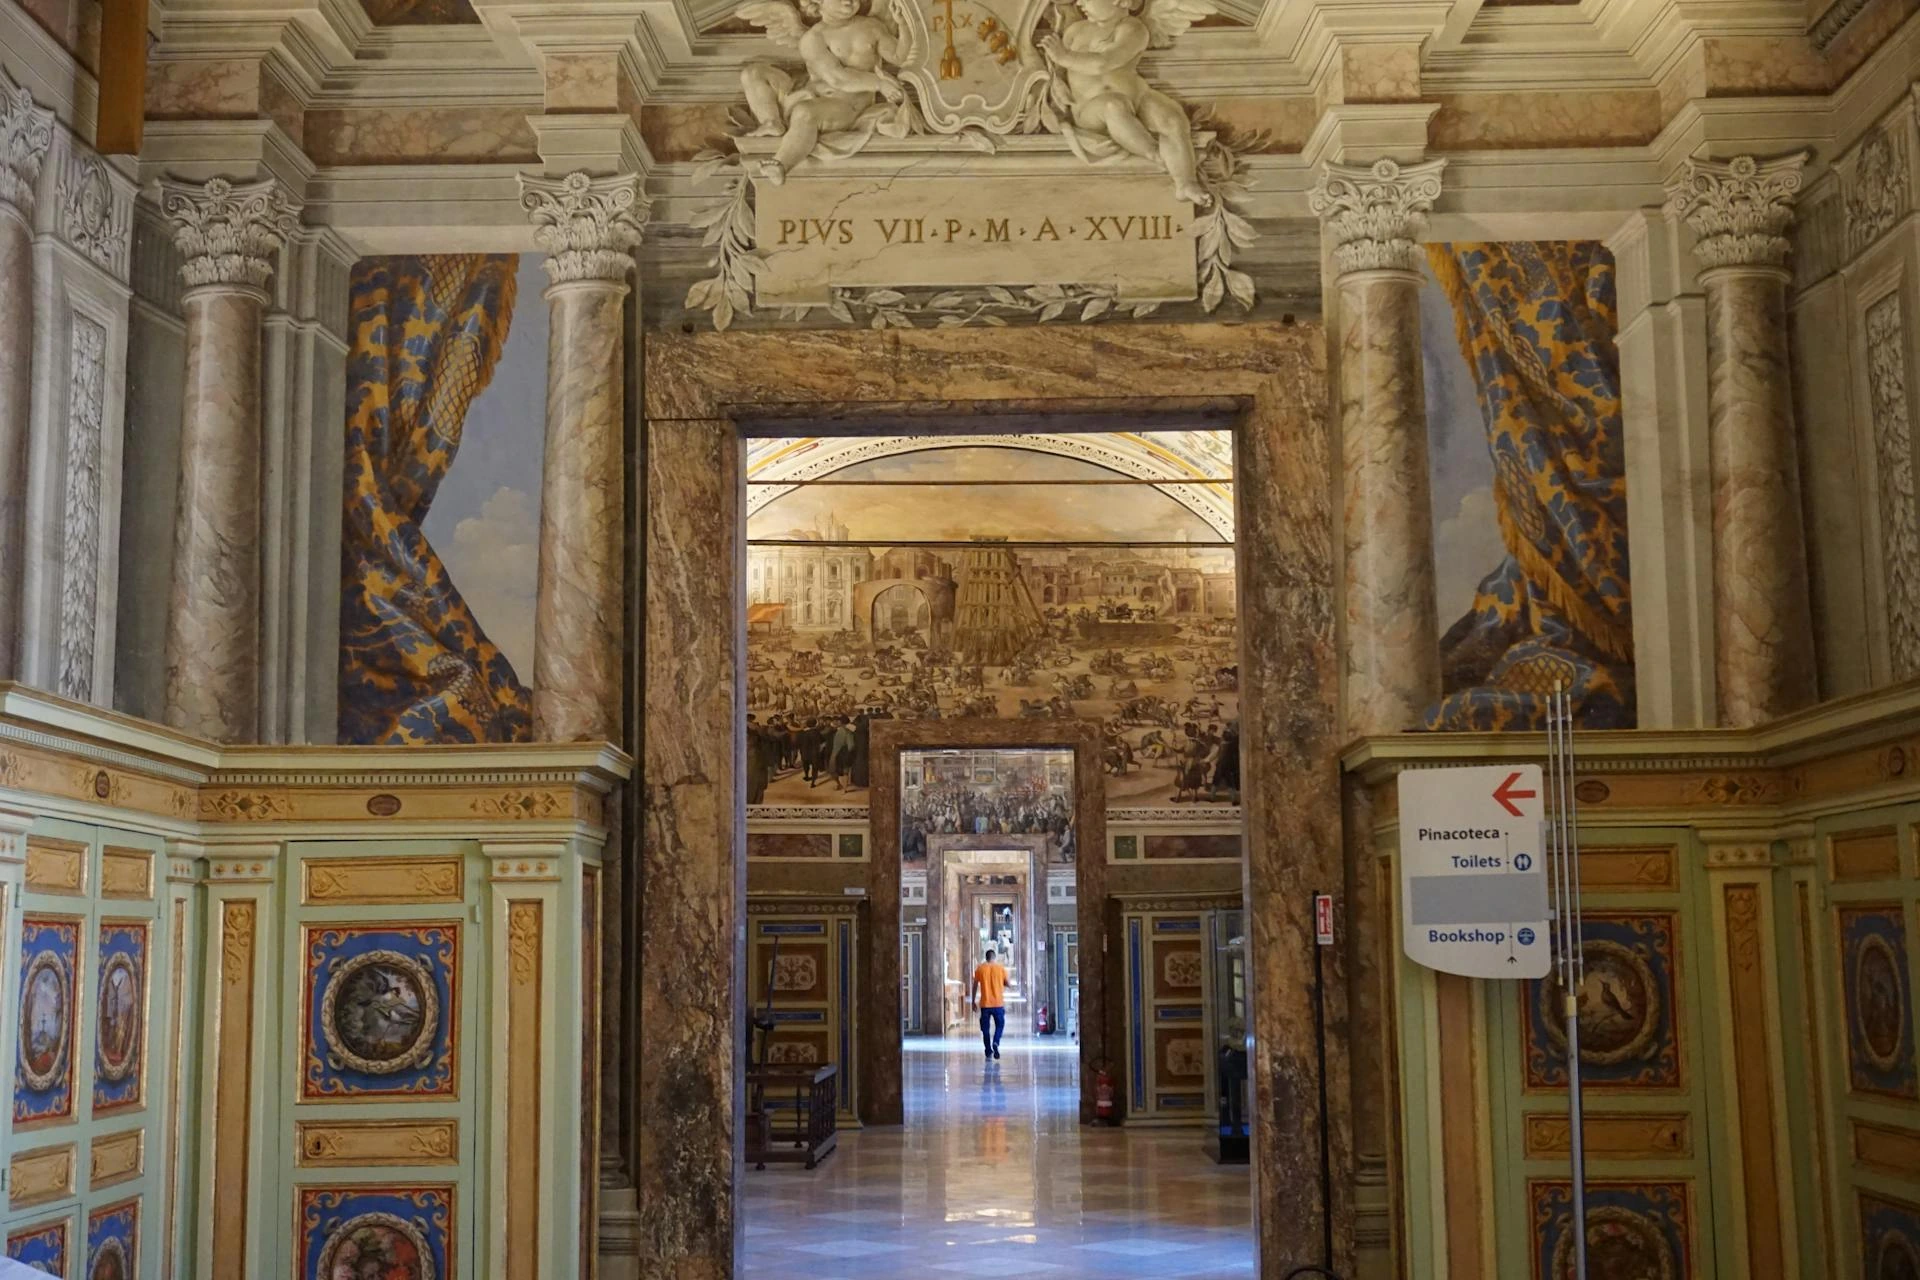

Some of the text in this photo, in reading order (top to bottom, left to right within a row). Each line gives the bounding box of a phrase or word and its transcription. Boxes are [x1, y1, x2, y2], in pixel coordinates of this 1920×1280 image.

[777, 219, 854, 245] PIVS
[1418, 828, 1500, 841] Pinacoteca
[1452, 855, 1501, 868] Toilets
[1429, 930, 1505, 944] Bookshop
